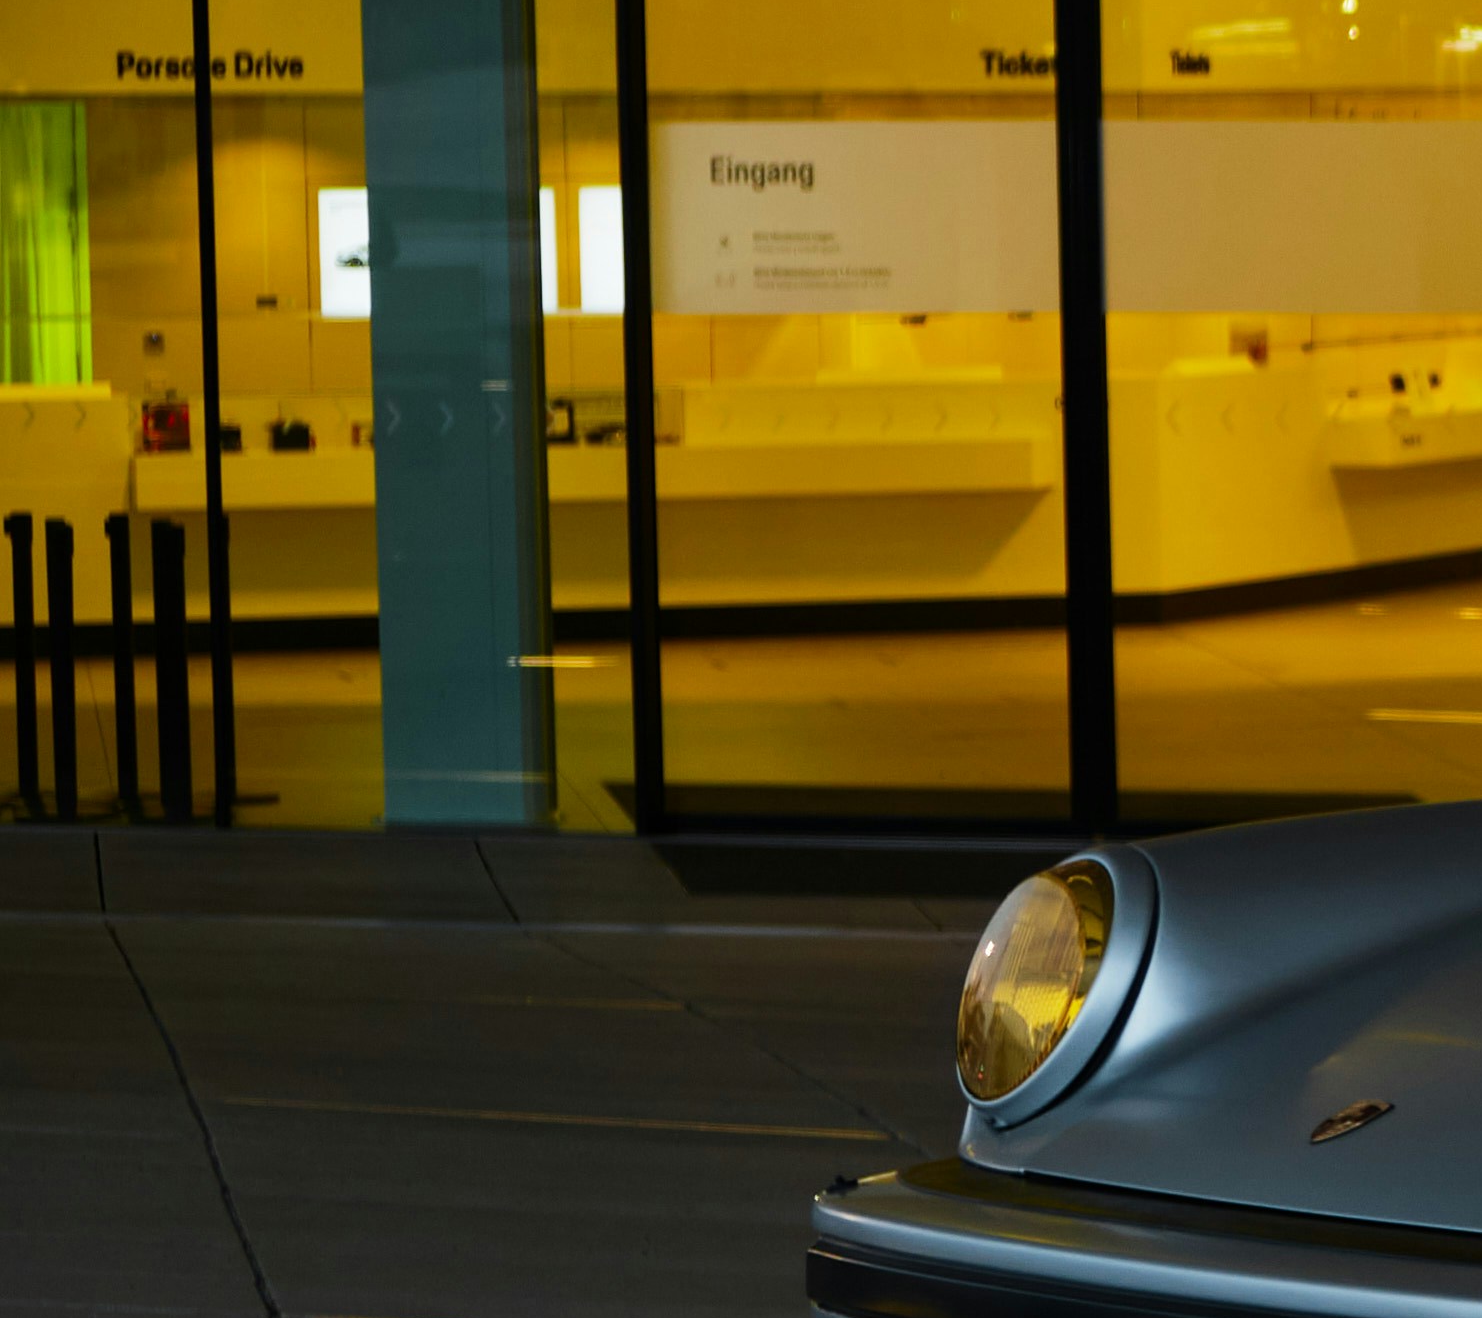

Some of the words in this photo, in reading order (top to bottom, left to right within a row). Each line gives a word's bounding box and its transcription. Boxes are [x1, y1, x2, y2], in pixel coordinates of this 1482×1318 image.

[116, 49, 227, 80] Porsce
[234, 49, 305, 79] Drive
[709, 154, 815, 192] Eingang
